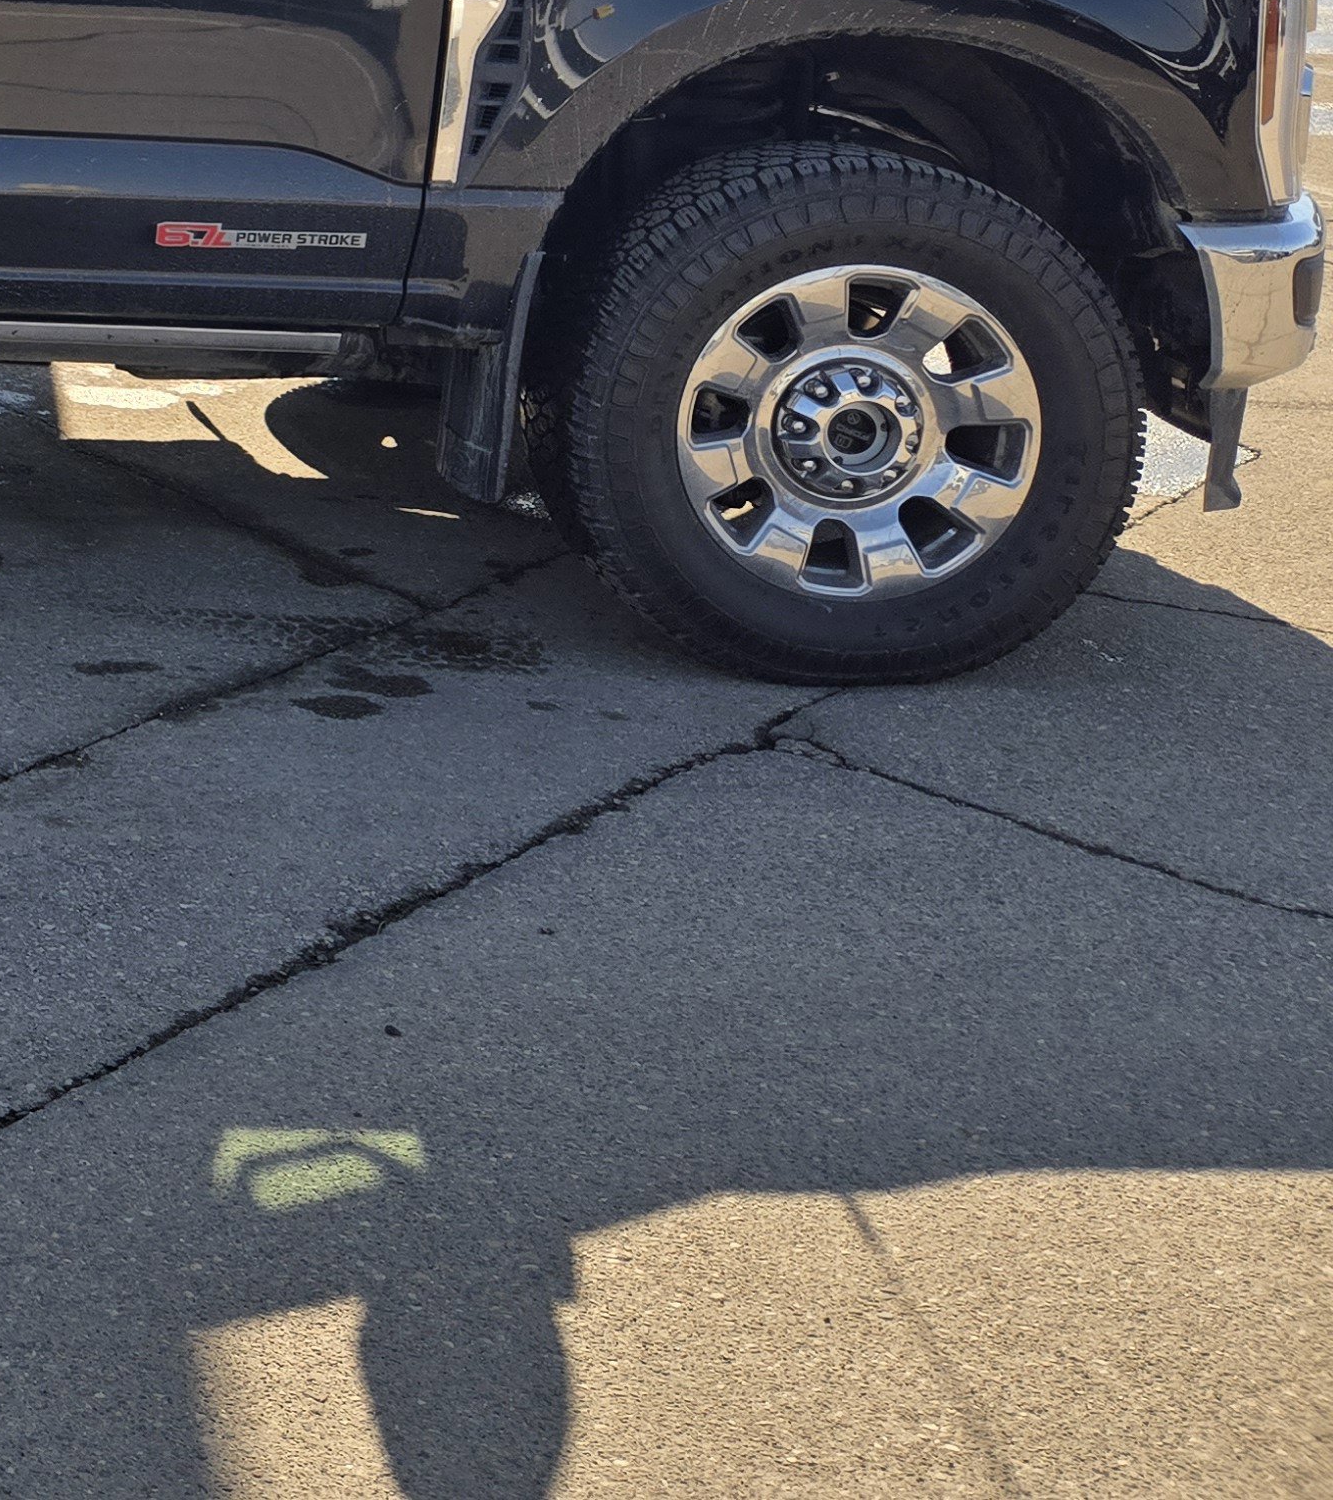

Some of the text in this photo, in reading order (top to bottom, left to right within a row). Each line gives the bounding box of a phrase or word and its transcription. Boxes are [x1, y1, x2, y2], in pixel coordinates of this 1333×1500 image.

[156, 222, 362, 248] 6.7L POWER STROKE
